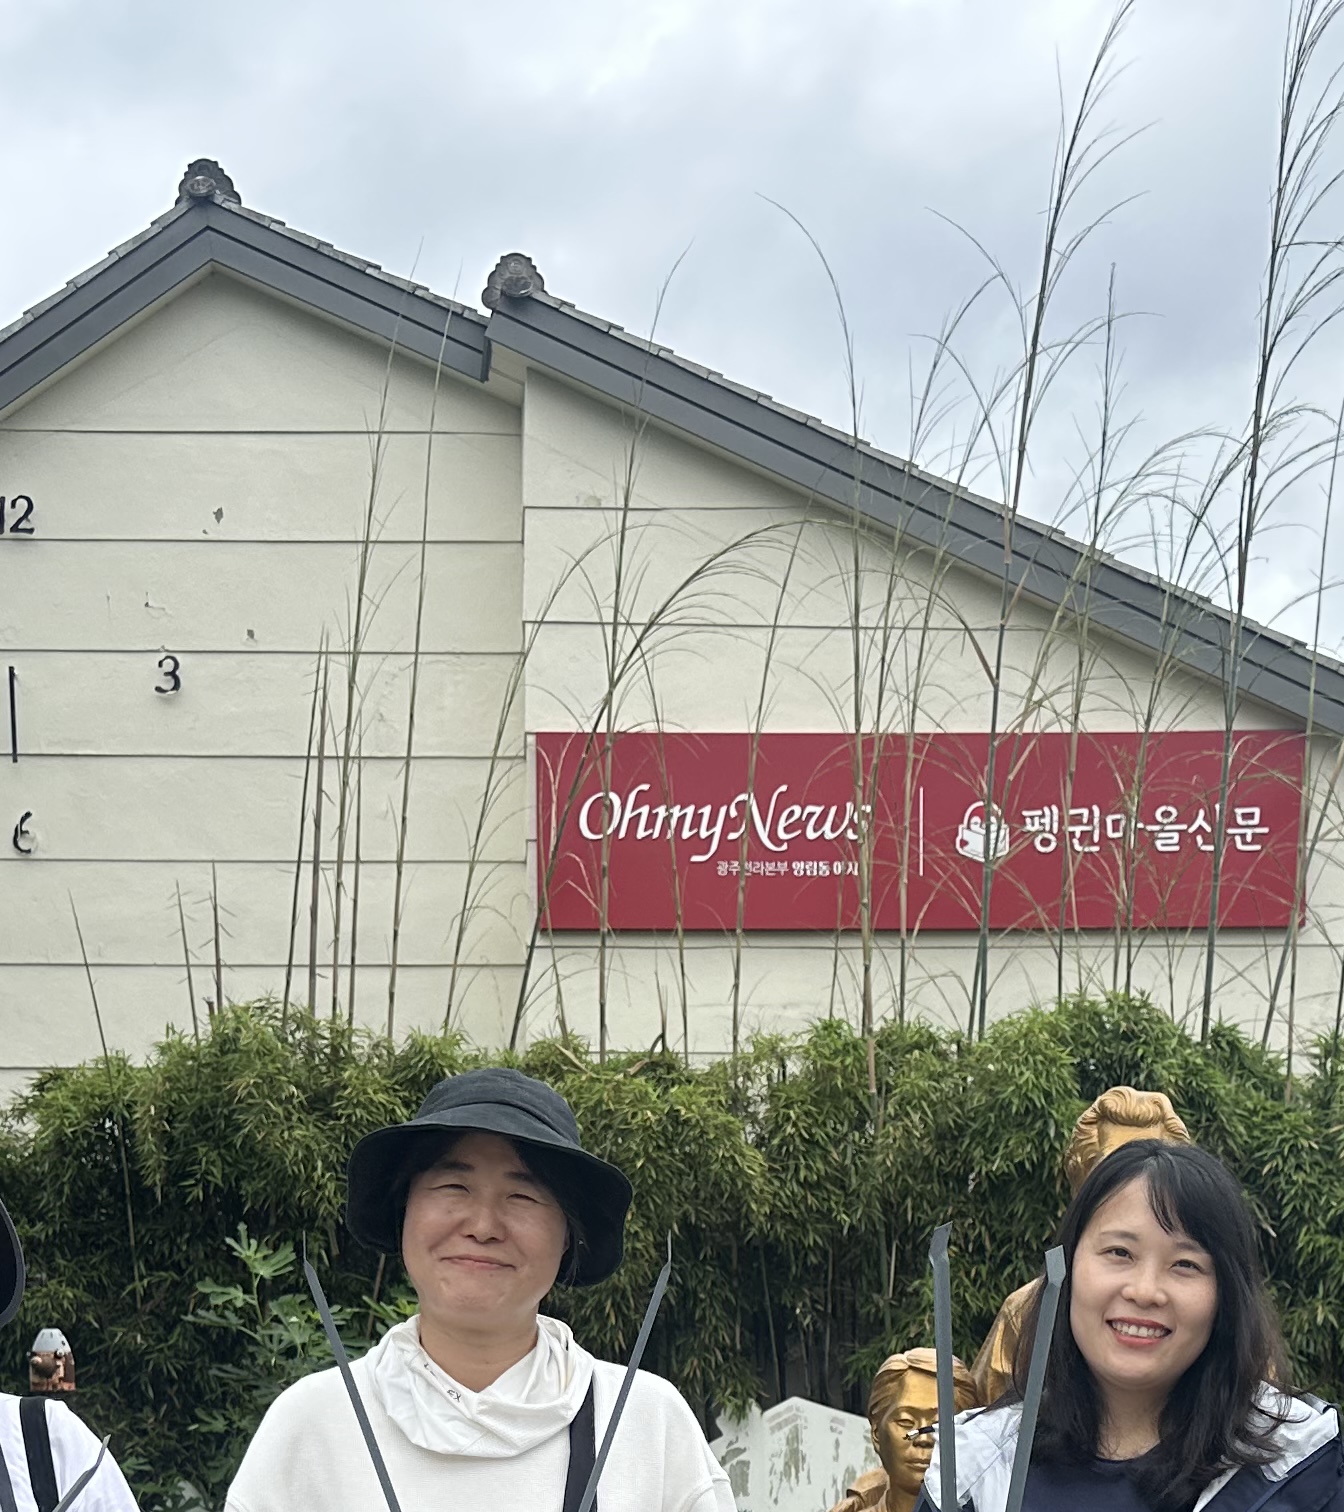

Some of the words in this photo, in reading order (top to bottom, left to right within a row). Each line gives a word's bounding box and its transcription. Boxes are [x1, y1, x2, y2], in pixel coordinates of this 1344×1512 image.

[155, 655, 181, 694] 3
[13, 811, 35, 854] 6
[1021, 804, 1270, 852] 펭귄마을신문
